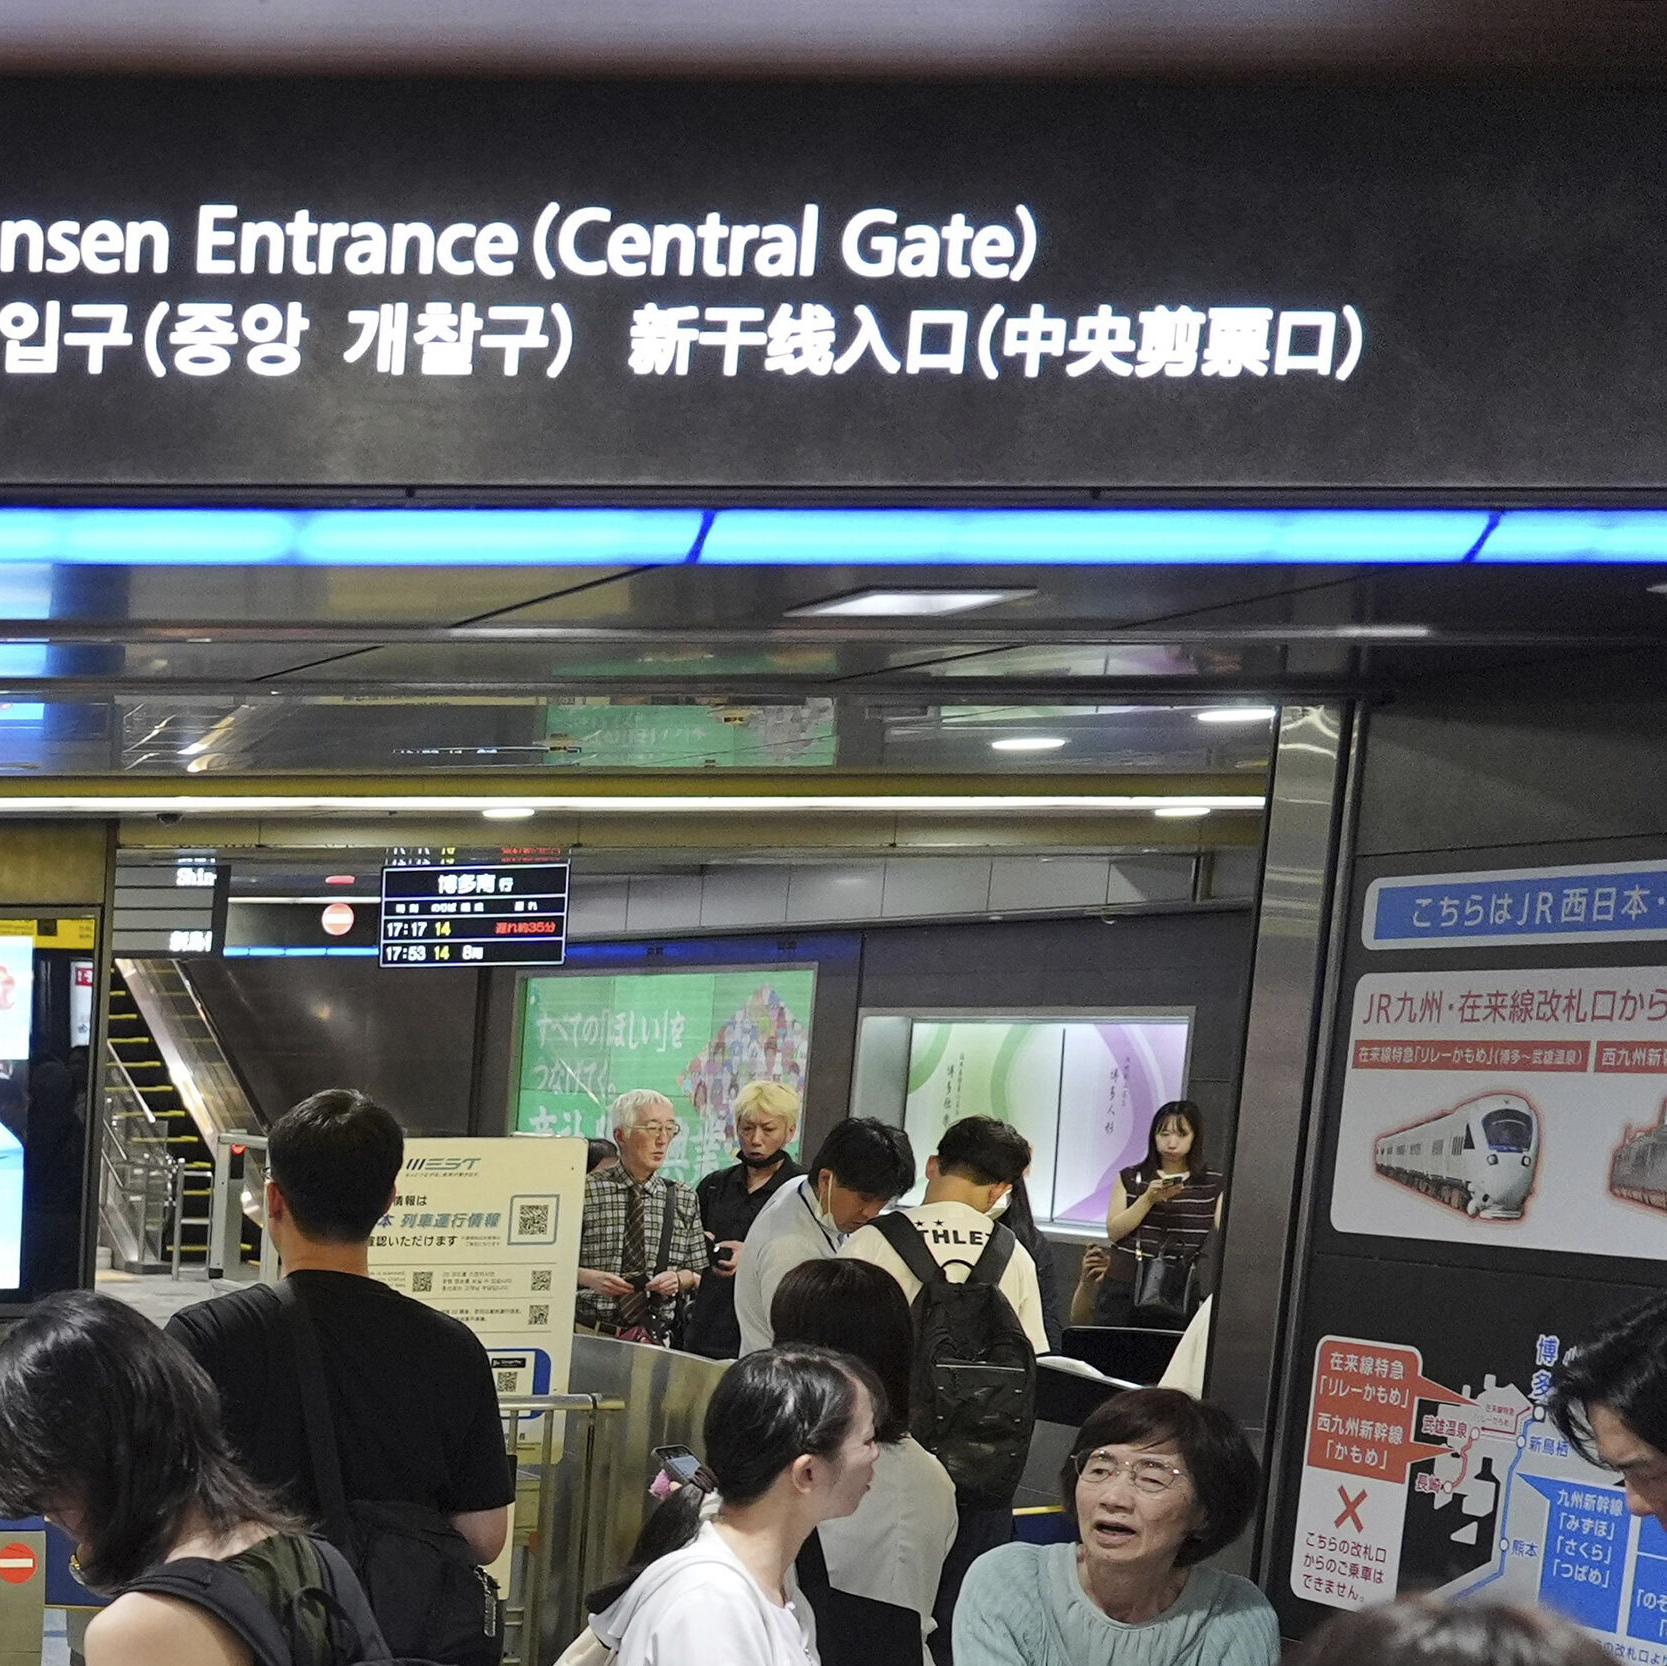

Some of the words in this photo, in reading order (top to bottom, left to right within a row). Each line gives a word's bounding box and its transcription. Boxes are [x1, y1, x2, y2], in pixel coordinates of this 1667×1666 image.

[841, 203, 1038, 283] Gate)
[342, 301, 573, 380] 개찰구)
[386, 921, 428, 937] 17:17
[434, 921, 452, 937] 14
[385, 945, 427, 961] 17:53
[433, 945, 451, 961] 14
[399, 1212, 503, 1229] 列車運行情報
[1330, 1351, 1406, 1381] 在来線特急
[1319, 1381, 1411, 1410] 「リレーかもめ」
[1317, 1412, 1404, 1445] 西九州新幹線
[1326, 1442, 1388, 1471] 「かもめ」
[1415, 1473, 1441, 1494] 長崎
[1556, 1488, 1624, 1517] 九州新幹線
[1559, 1511, 1616, 1541] 「みずほ」
[1305, 1531, 1388, 1564] こちらの改札口
[1511, 1538, 1539, 1559] 熊本
[1556, 1537, 1613, 1565] 「さくら」
[1303, 1553, 1385, 1584] からのご乗車は
[1552, 1559, 1611, 1589] 「つばめ」
[1301, 1573, 1366, 1602] できません。
